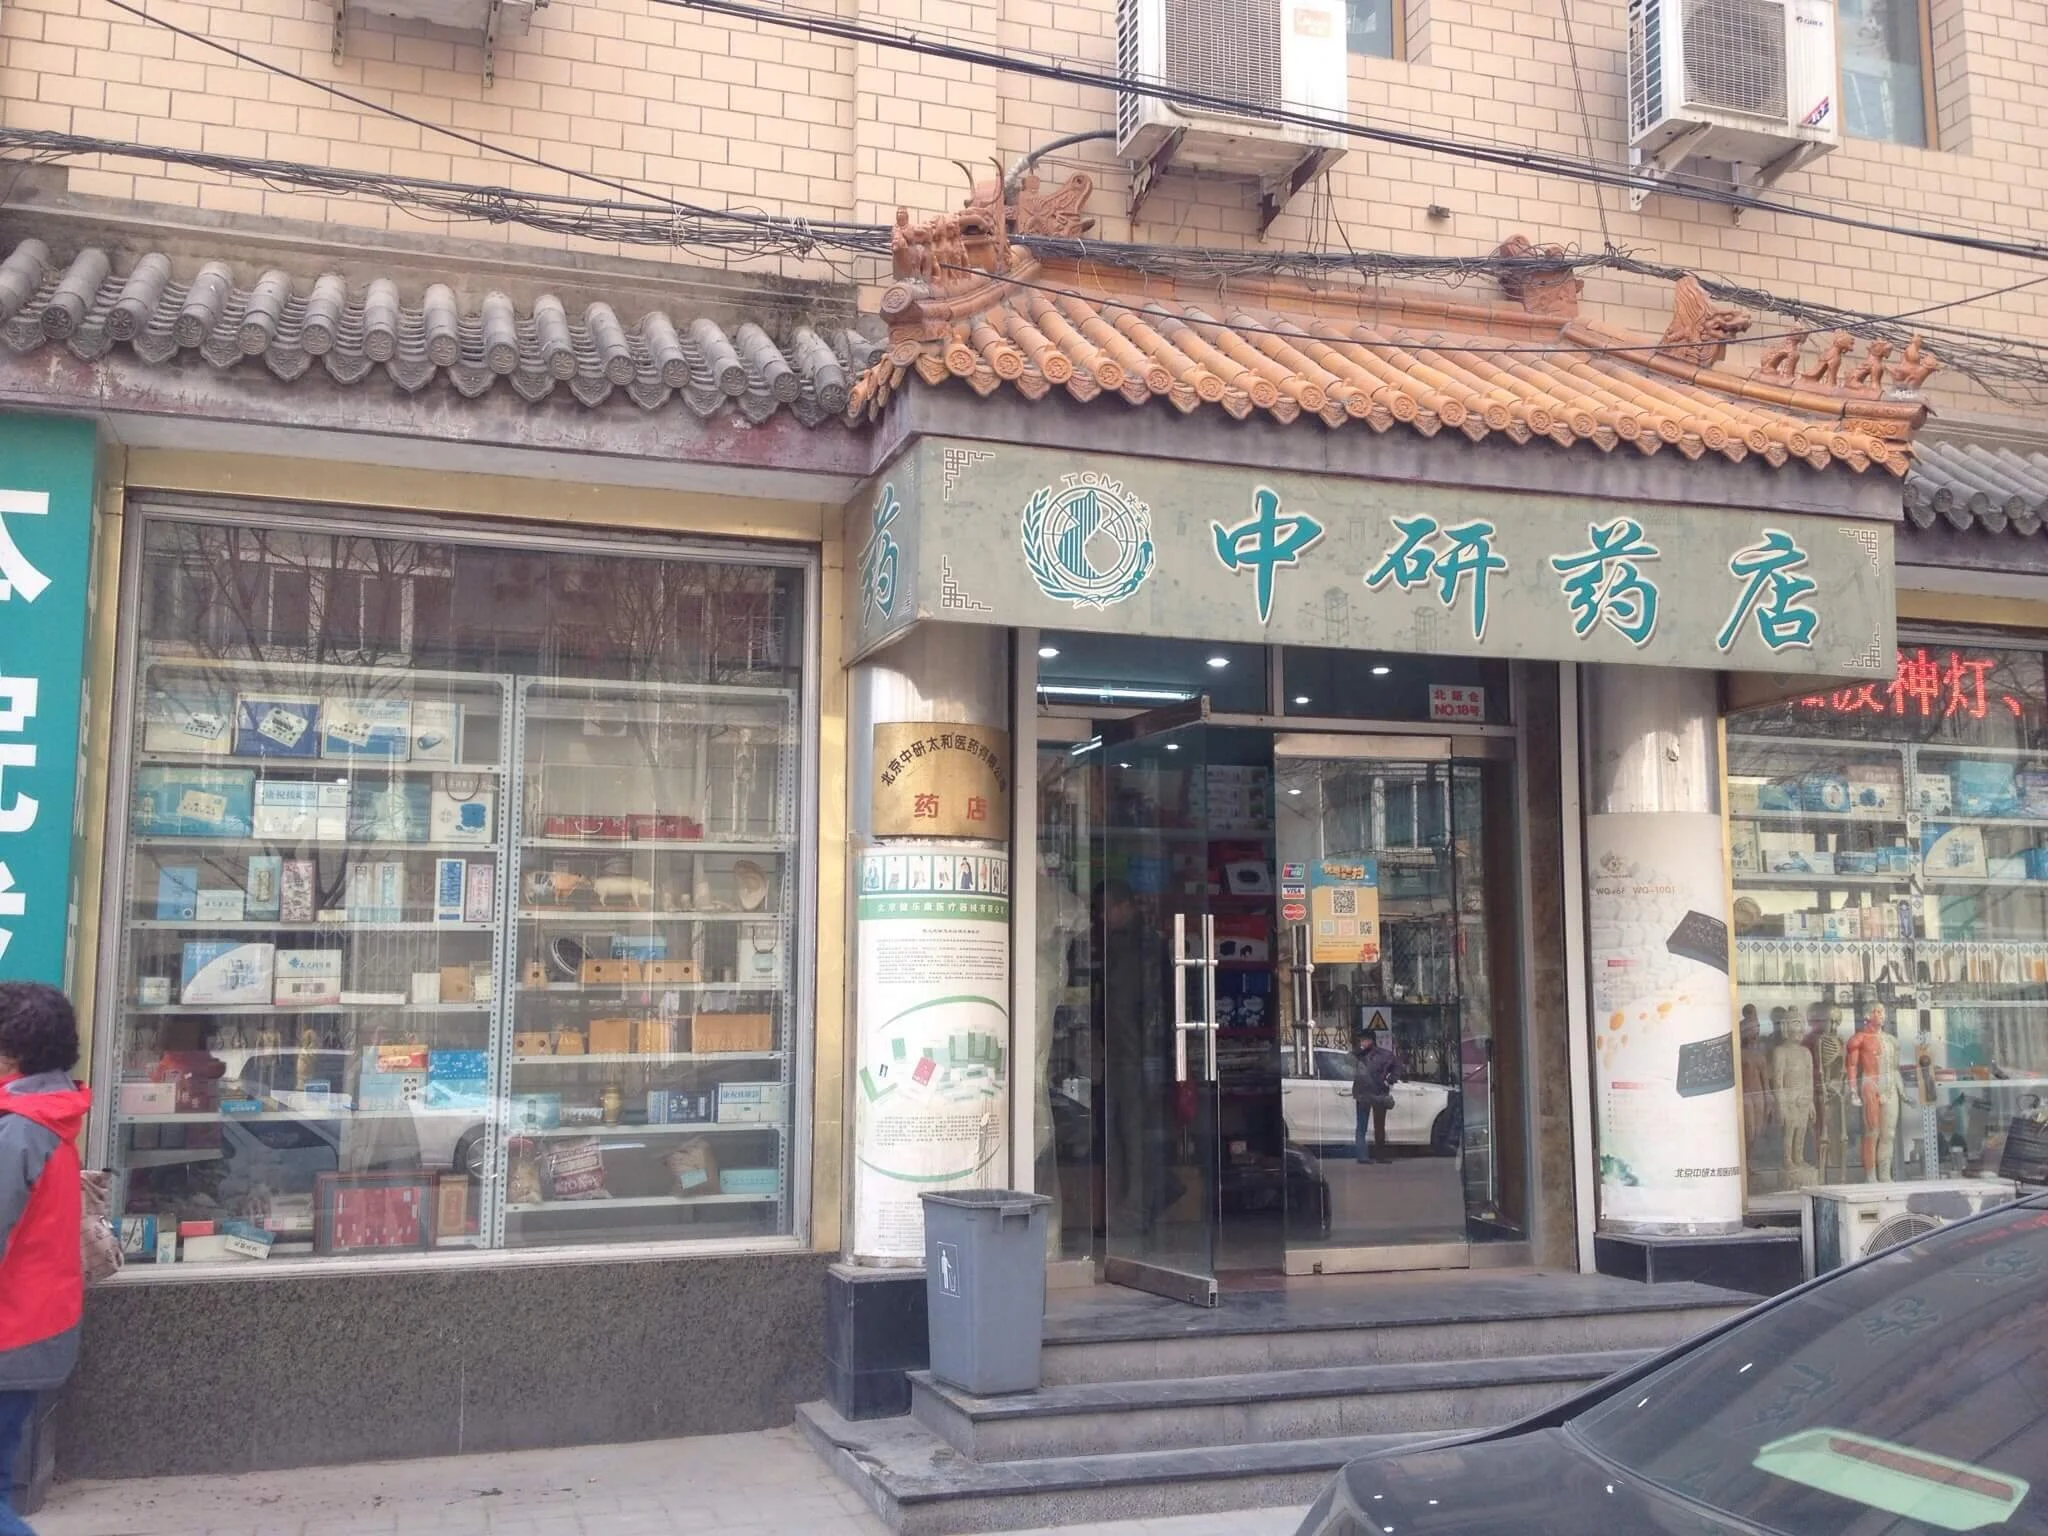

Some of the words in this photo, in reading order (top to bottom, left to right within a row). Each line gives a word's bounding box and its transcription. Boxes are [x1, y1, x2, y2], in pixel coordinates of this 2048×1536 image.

[1062, 471, 1122, 493] TCM
[1211, 484, 1820, 655] 中研药店
[914, 793, 988, 821] 药店
